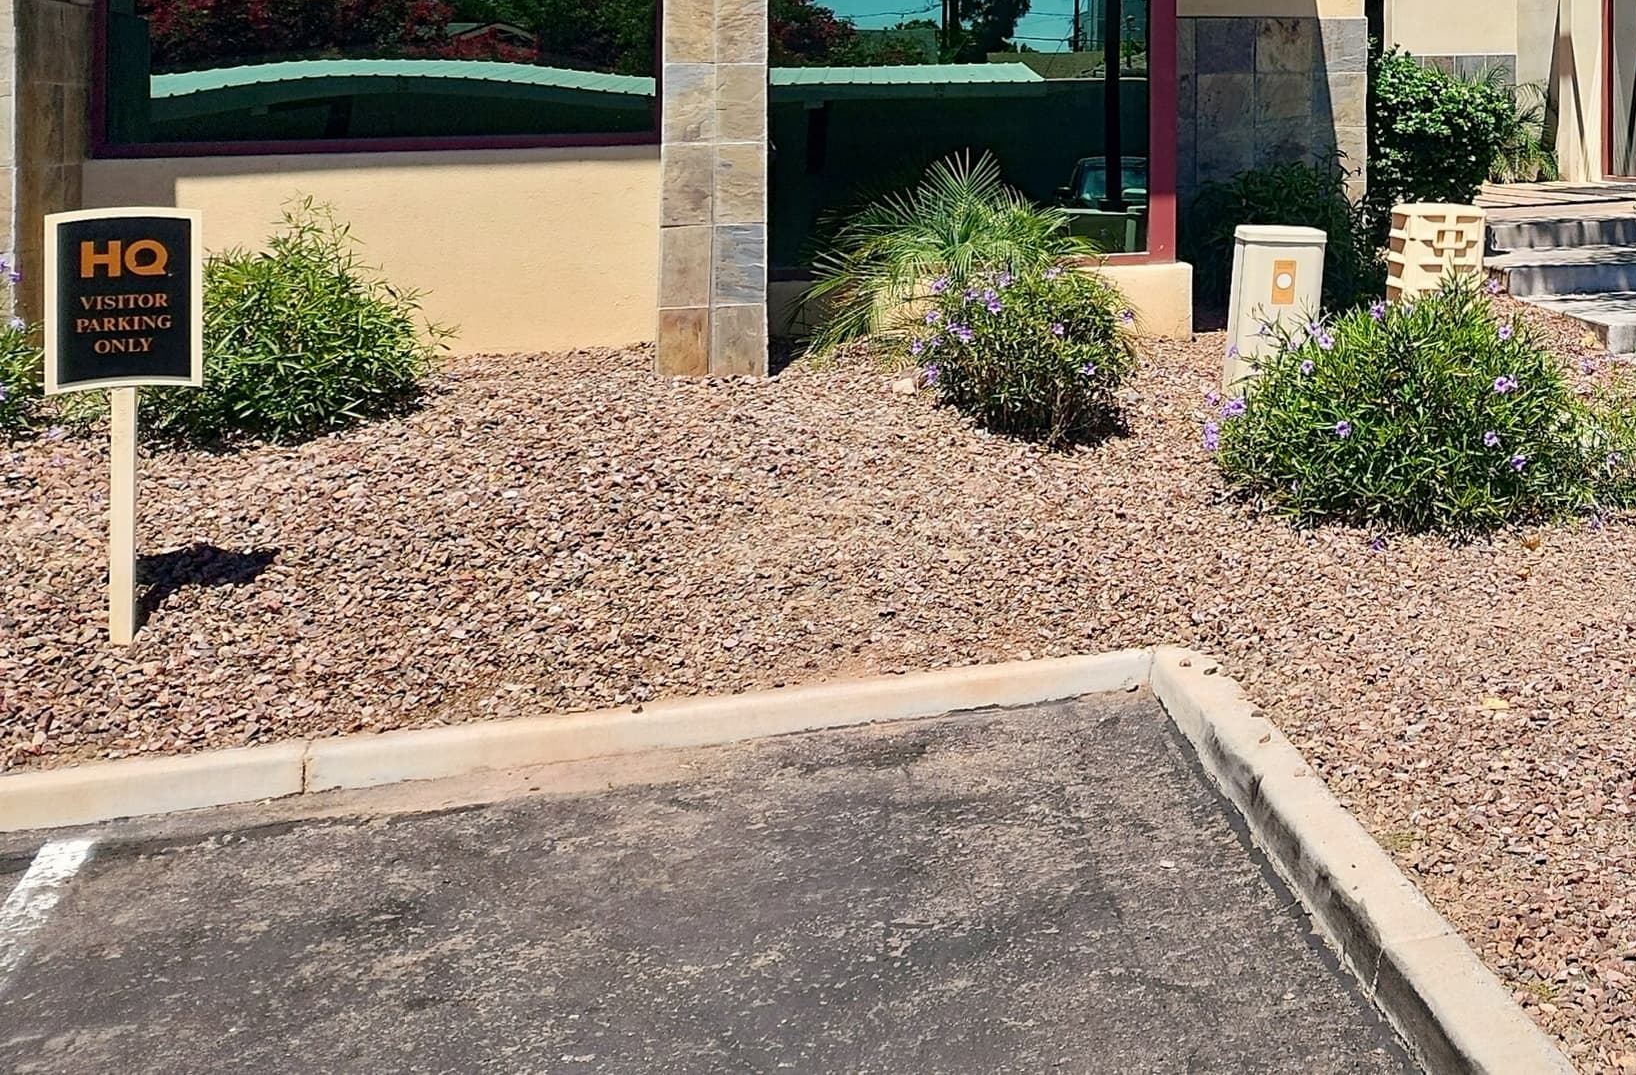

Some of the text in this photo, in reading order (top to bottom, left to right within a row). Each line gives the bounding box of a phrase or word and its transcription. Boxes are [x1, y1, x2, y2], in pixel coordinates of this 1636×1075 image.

[81, 239, 168, 278] HQ
[80, 293, 168, 310] VISITOR
[76, 315, 172, 333] PARKING
[94, 337, 153, 354] ONLY
